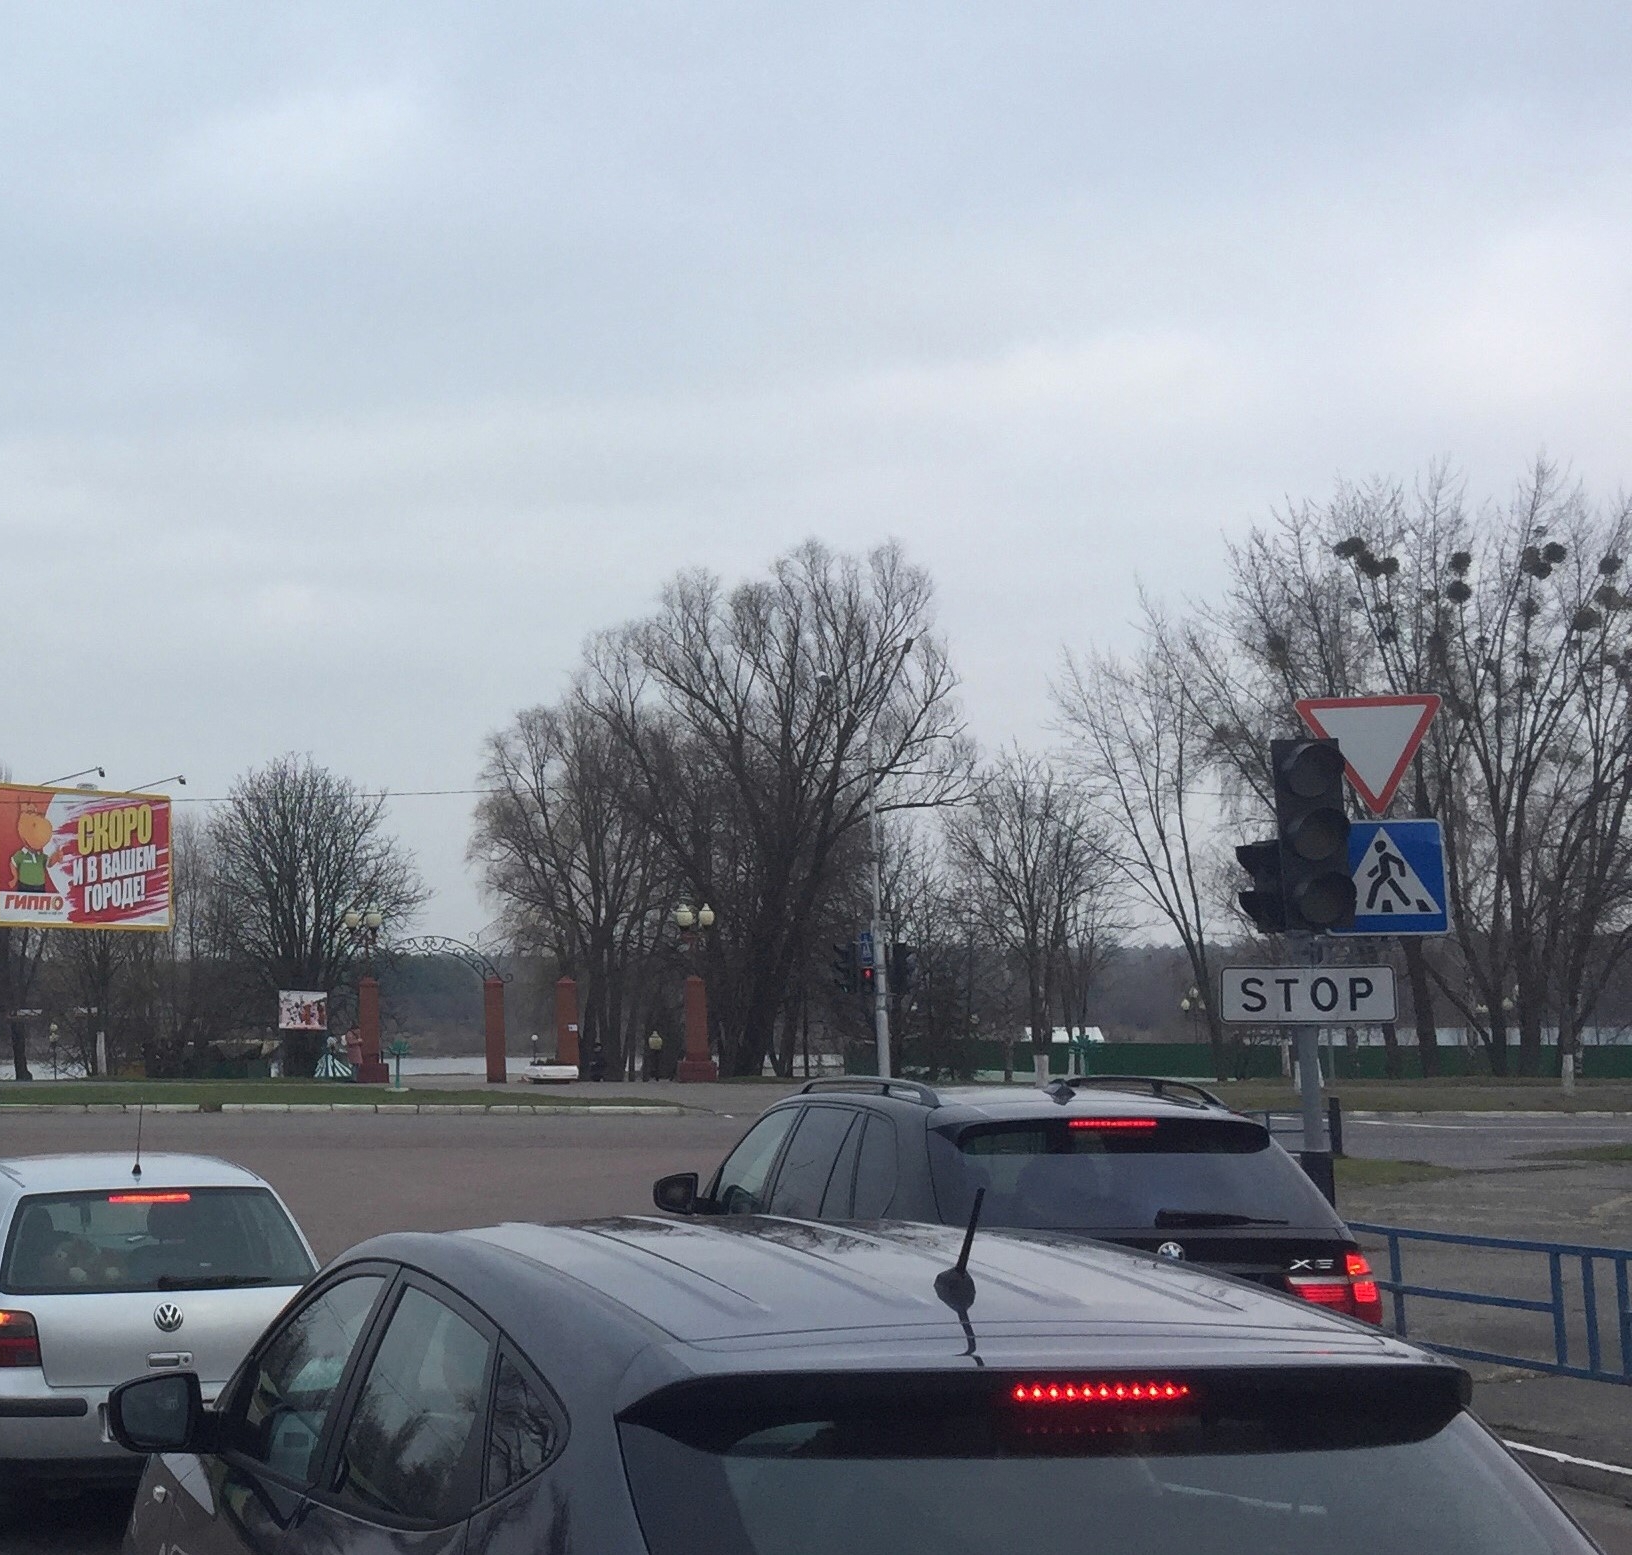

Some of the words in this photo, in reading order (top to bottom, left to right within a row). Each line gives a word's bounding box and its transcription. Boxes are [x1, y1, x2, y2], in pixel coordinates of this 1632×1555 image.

[77, 803, 153, 856] СКОРО
[73, 857, 84, 886] И
[87, 855, 98, 883] В
[101, 844, 157, 881] ВАШЕМ
[5, 894, 65, 911] ГИППО
[84, 875, 146, 913] ГОРОДЕ!
[1240, 976, 1374, 1013] STOP
